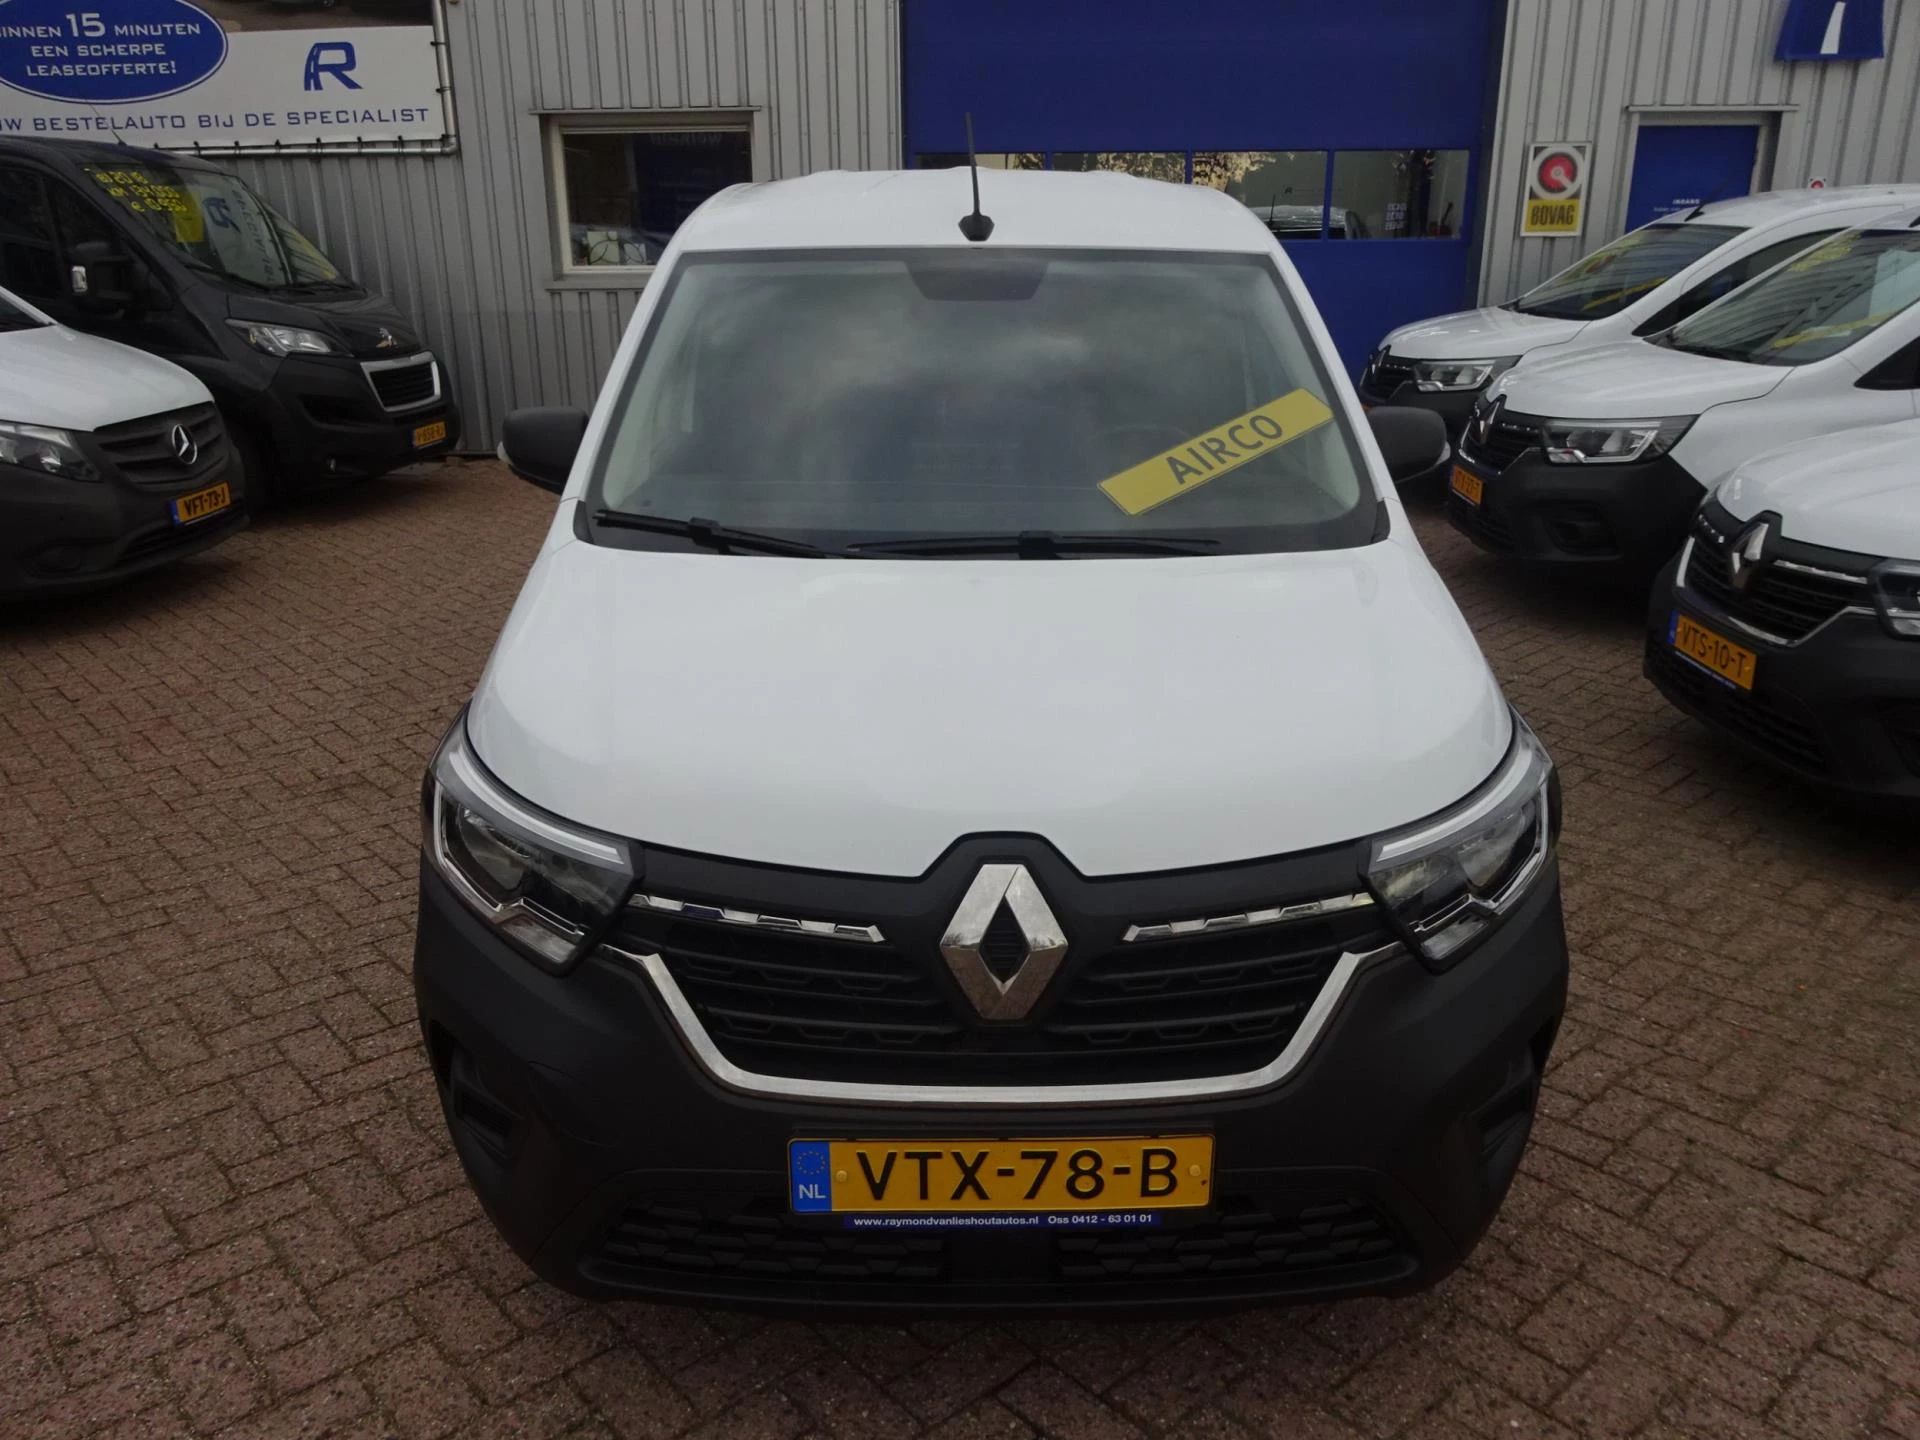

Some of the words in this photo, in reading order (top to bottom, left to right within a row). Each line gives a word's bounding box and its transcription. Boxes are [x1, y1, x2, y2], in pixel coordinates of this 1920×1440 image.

[0, 26, 62, 38] INNEN
[65, 12, 106, 37] 15
[114, 23, 201, 37] MINUTEN
[30, 45, 69, 58] EEN
[77, 43, 166, 57] SCHERPE
[26, 60, 177, 77] LEASEOFFERTE!
[0, 117, 22, 131] W
[33, 114, 186, 131] BESTELAUTO
[198, 114, 234, 129] BIJ
[245, 112, 276, 127] DE
[286, 108, 430, 126] SPECIALIST
[1530, 204, 1575, 226] BOVAG
[1164, 415, 1283, 485] AIRCO
[1682, 622, 1747, 678] VTS-10-T
[855, 1147, 1178, 1201] VTX-78-B
[798, 1183, 827, 1199] NL
[853, 1215, 1039, 1228] www.raymondvanlieshoutautos.nl
[1047, 1215, 1070, 1224] Oss
[1072, 1214, 1098, 1224] 0412
[1107, 1214, 1122, 1224] 63
[1123, 1214, 1137, 1223] 01
[1138, 1213, 1152, 1223] 01
